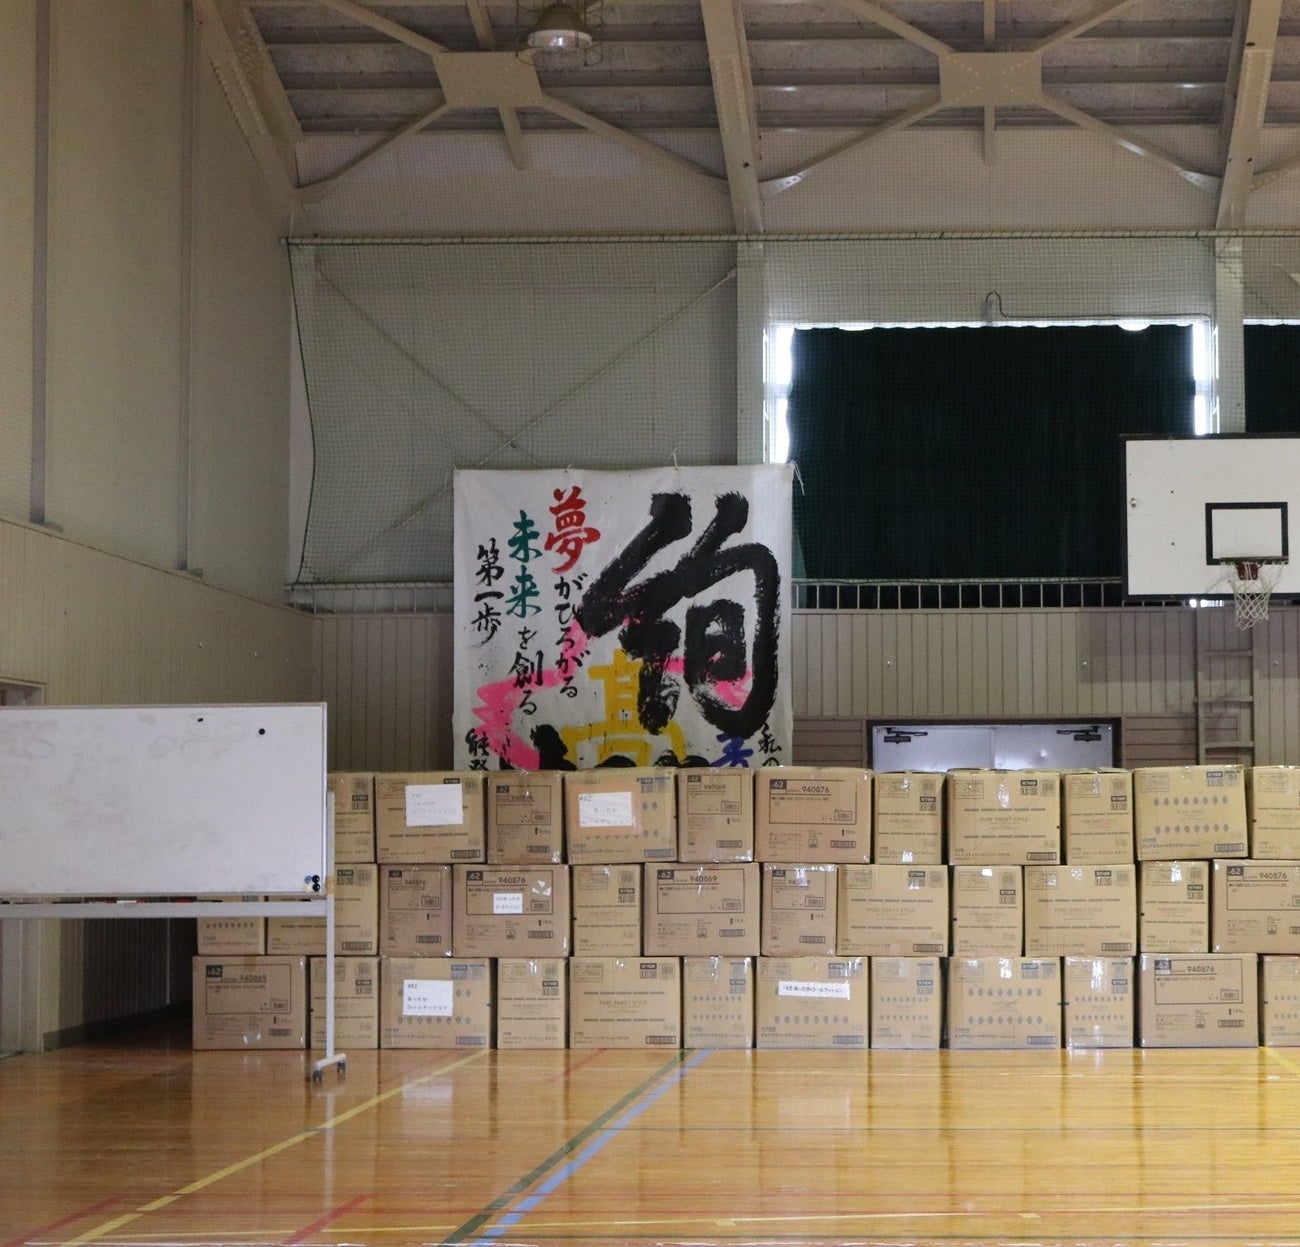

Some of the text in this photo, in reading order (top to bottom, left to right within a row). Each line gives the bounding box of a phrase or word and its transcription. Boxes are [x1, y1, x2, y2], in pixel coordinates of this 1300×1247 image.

[471, 537, 505, 647] 第一歩
[505, 509, 543, 716] 未来を創る
[544, 485, 601, 699] 夢がひろがる
[802, 786, 830, 794] 940876
[1259, 872, 1287, 880] 940876
[1187, 965, 1215, 973] 940876
